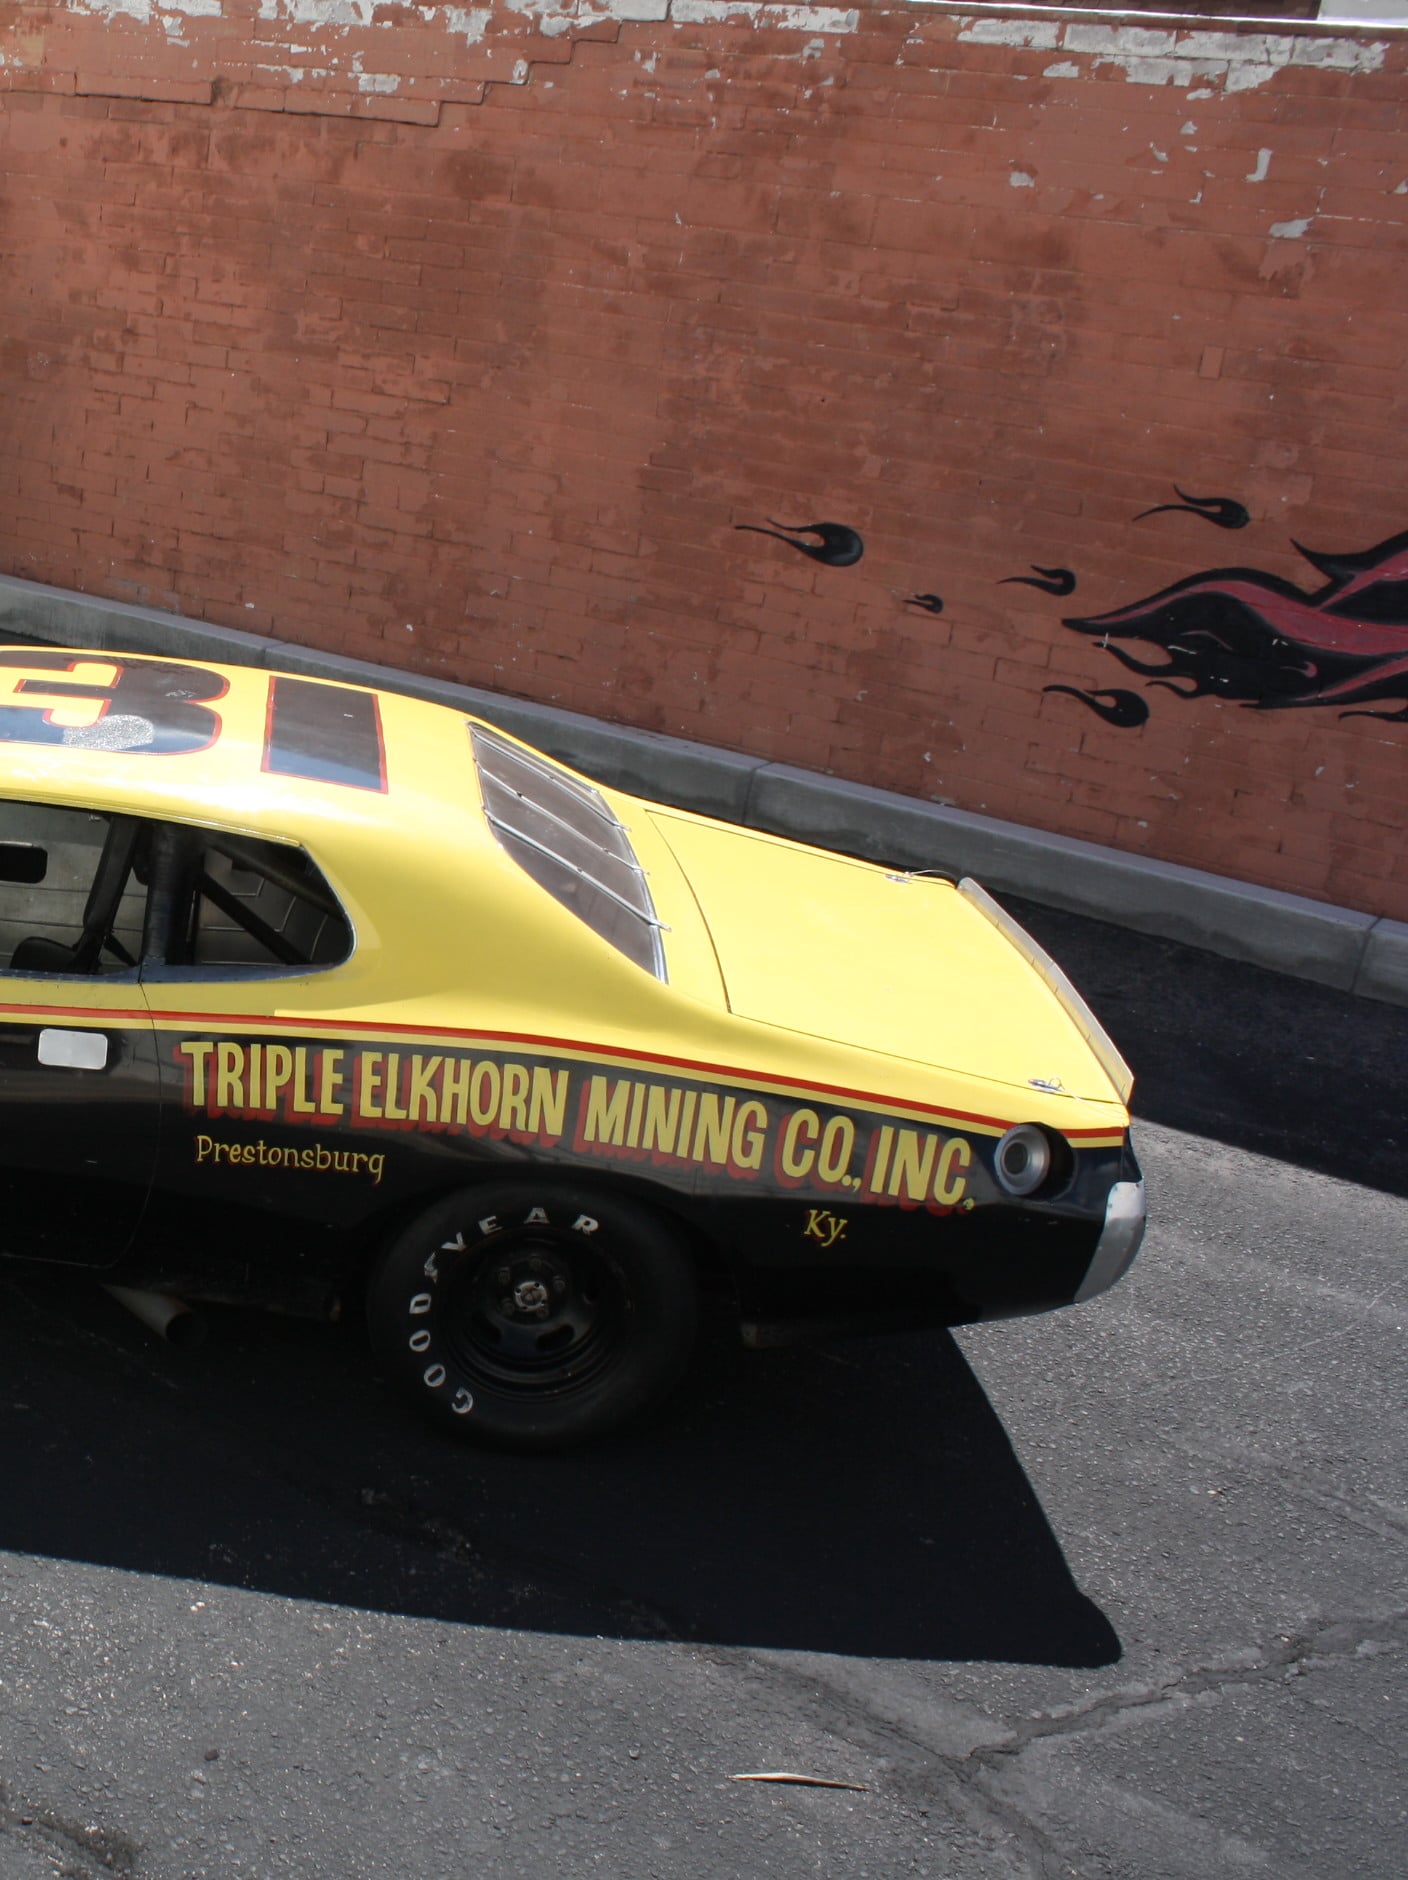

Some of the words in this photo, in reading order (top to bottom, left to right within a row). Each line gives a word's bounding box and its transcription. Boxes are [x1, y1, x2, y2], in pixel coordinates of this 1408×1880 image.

[177, 1041, 344, 1118] TRIPLE
[357, 1050, 569, 1138] ELKHORN
[579, 1072, 768, 1174] MINING
[195, 1134, 386, 1183] Prestonsburg
[804, 1208, 848, 1247] Ky.
